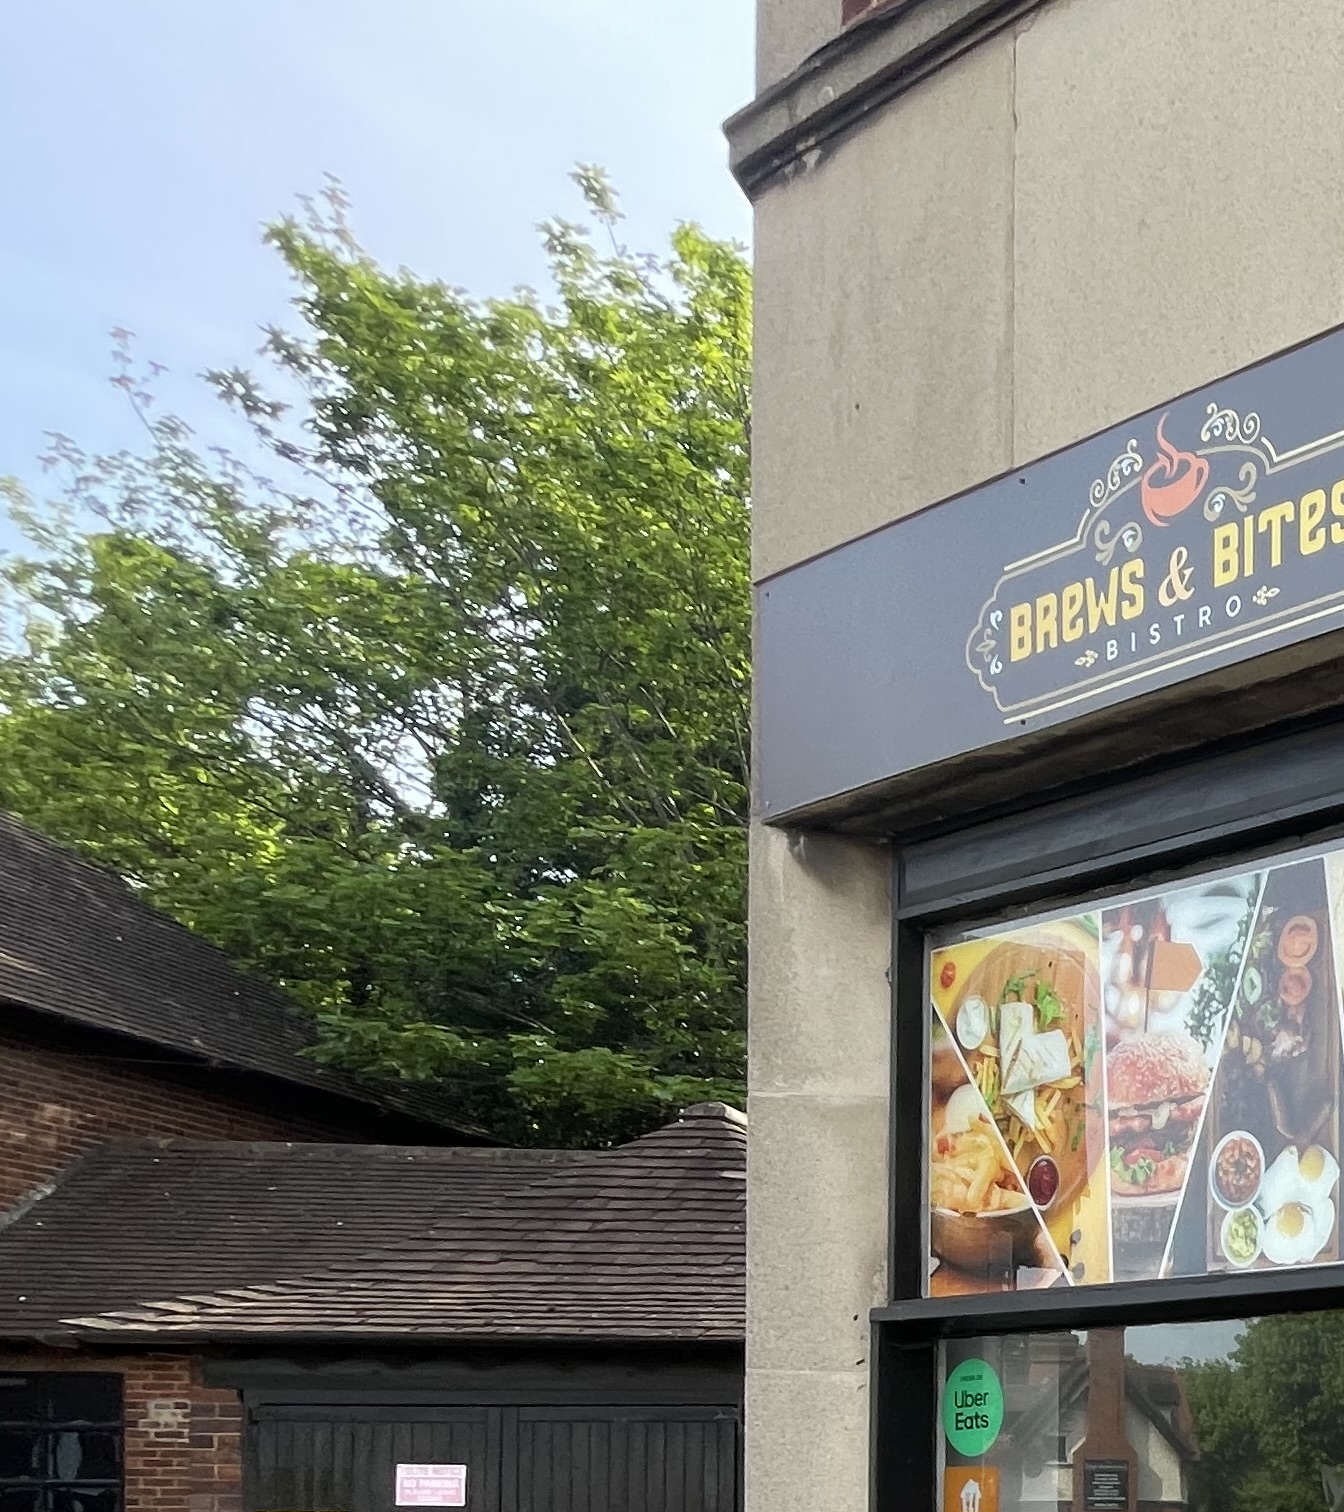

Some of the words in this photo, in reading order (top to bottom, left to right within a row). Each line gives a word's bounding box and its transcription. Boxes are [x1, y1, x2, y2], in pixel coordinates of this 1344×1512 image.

[1158, 546, 1195, 607] &
[1106, 595, 1243, 661] BISTRO
[954, 1390, 989, 1409] Uber
[954, 1412, 989, 1431] Eats
